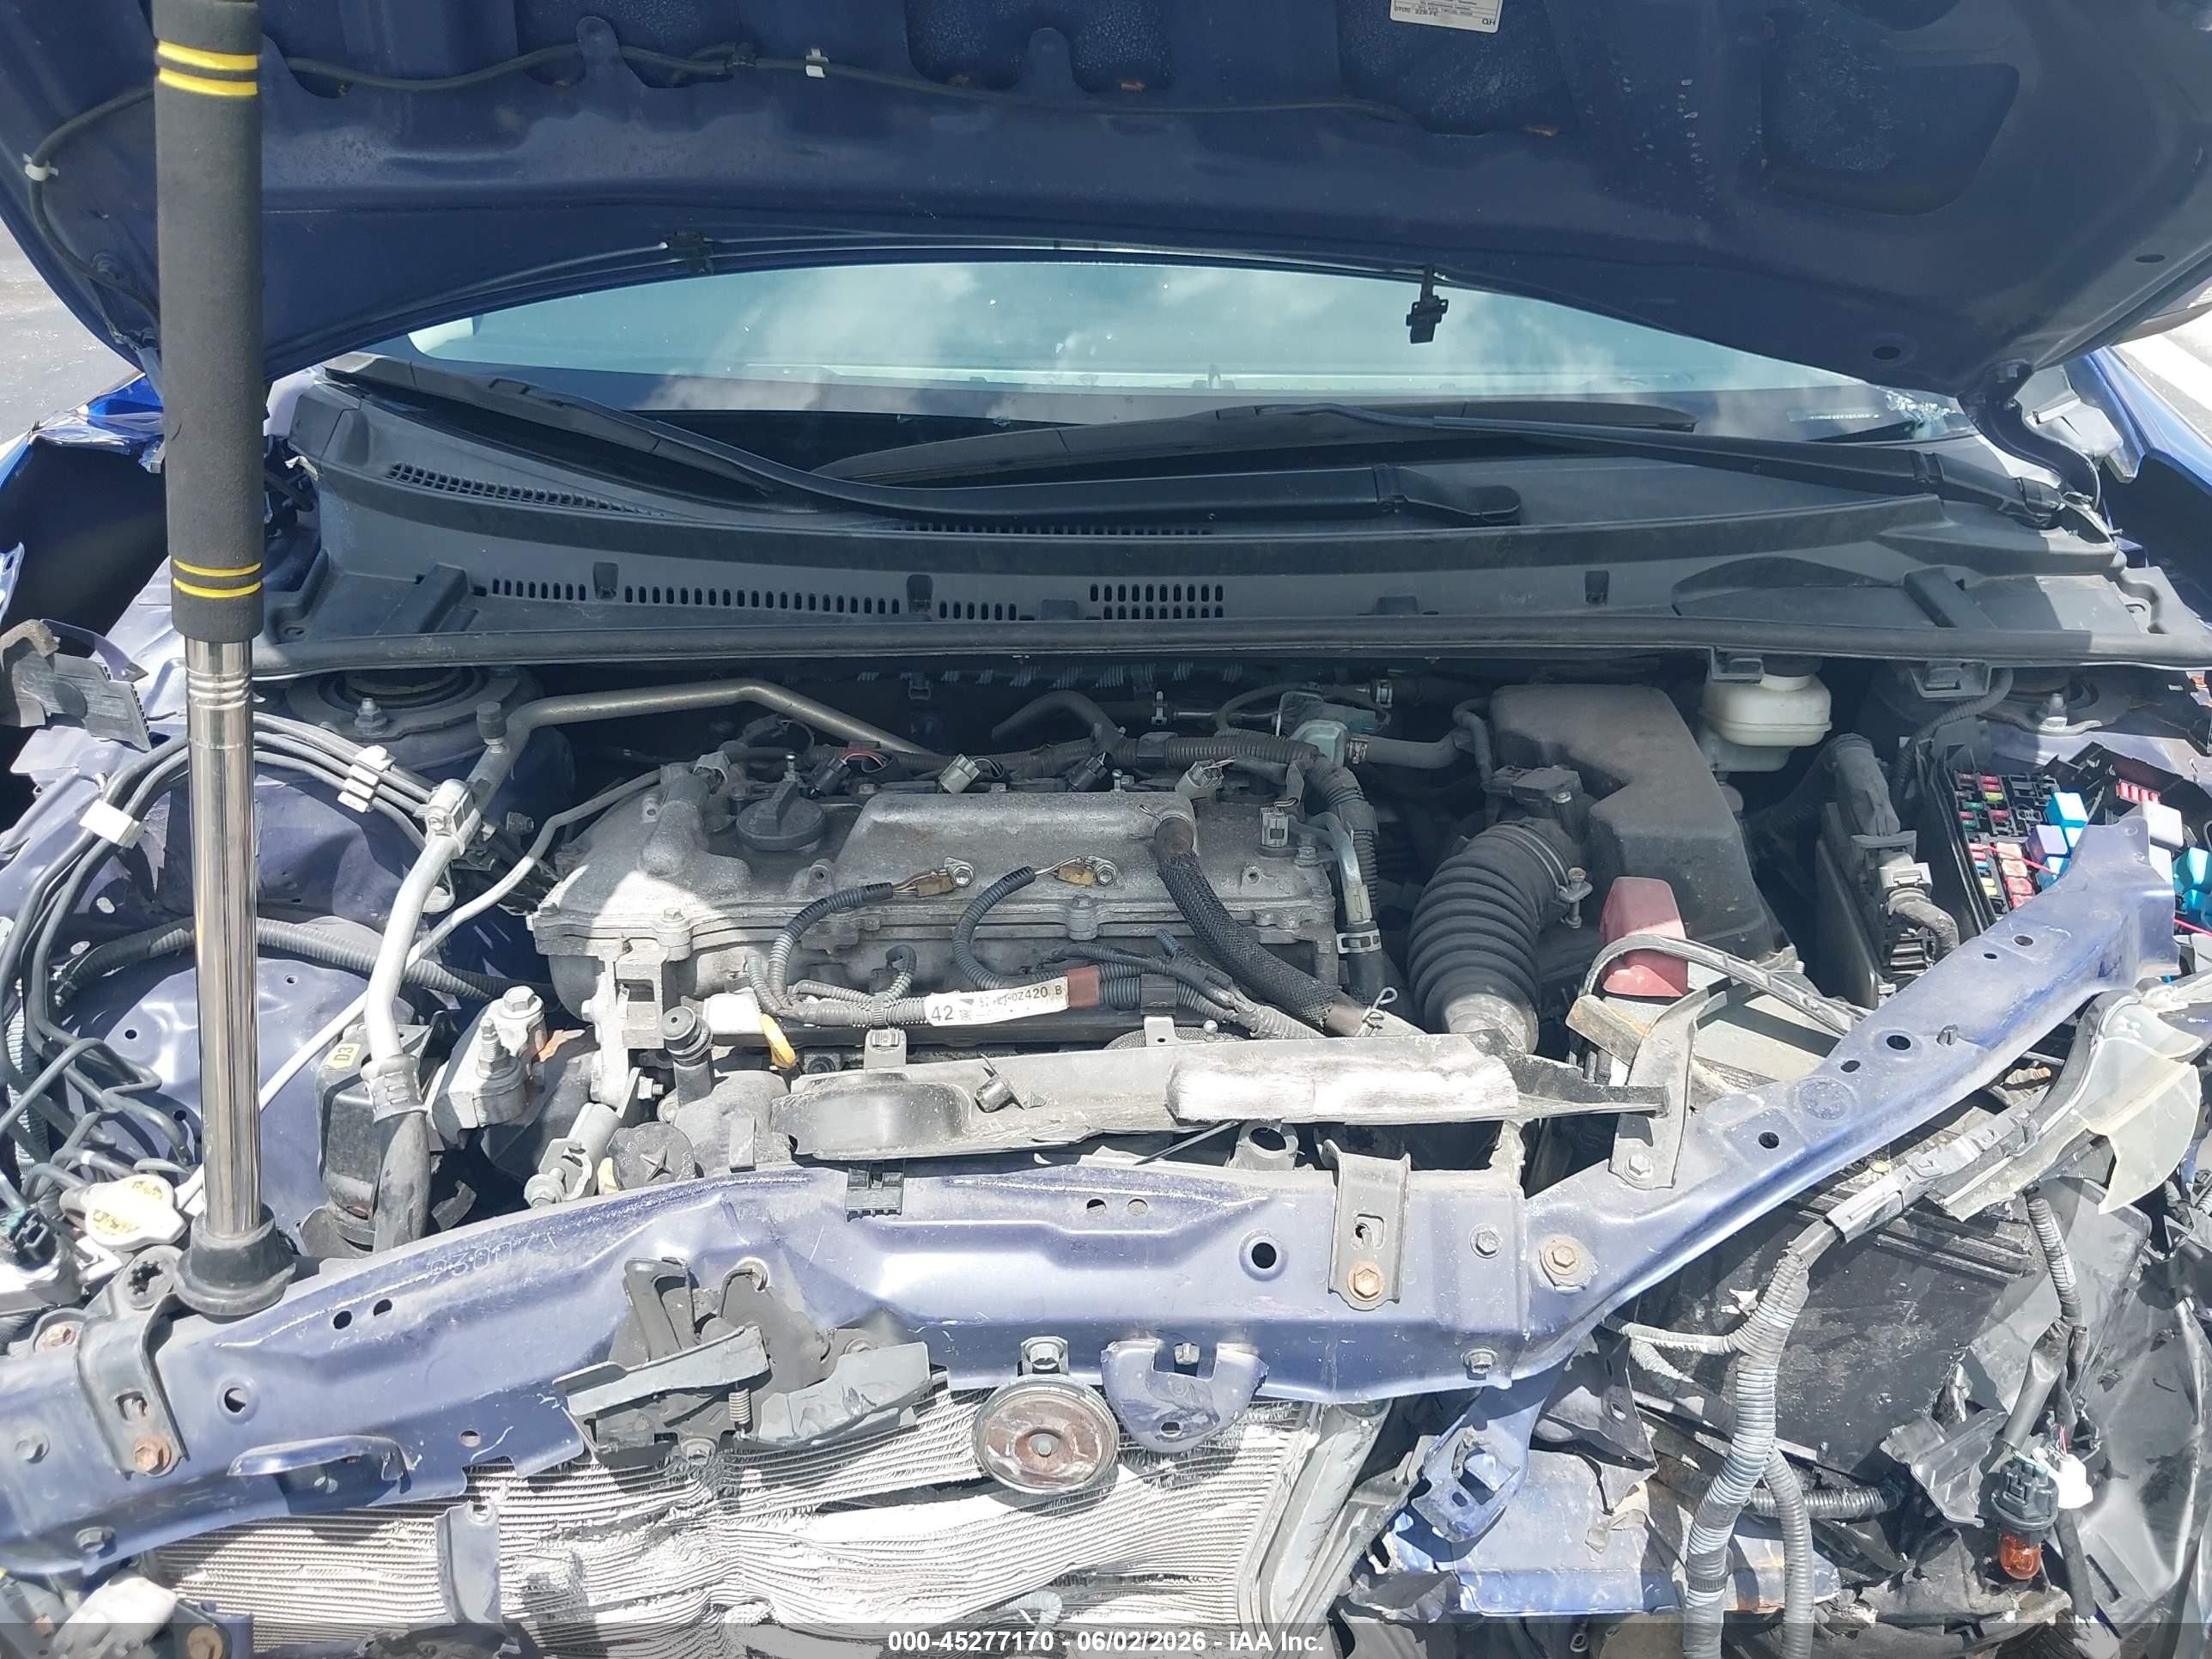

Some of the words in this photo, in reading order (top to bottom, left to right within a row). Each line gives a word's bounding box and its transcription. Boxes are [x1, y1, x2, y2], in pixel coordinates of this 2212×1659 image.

[1054, 984, 1063, 995] B
[931, 1005, 955, 1021] 42
[334, 1047, 354, 1060] D3
